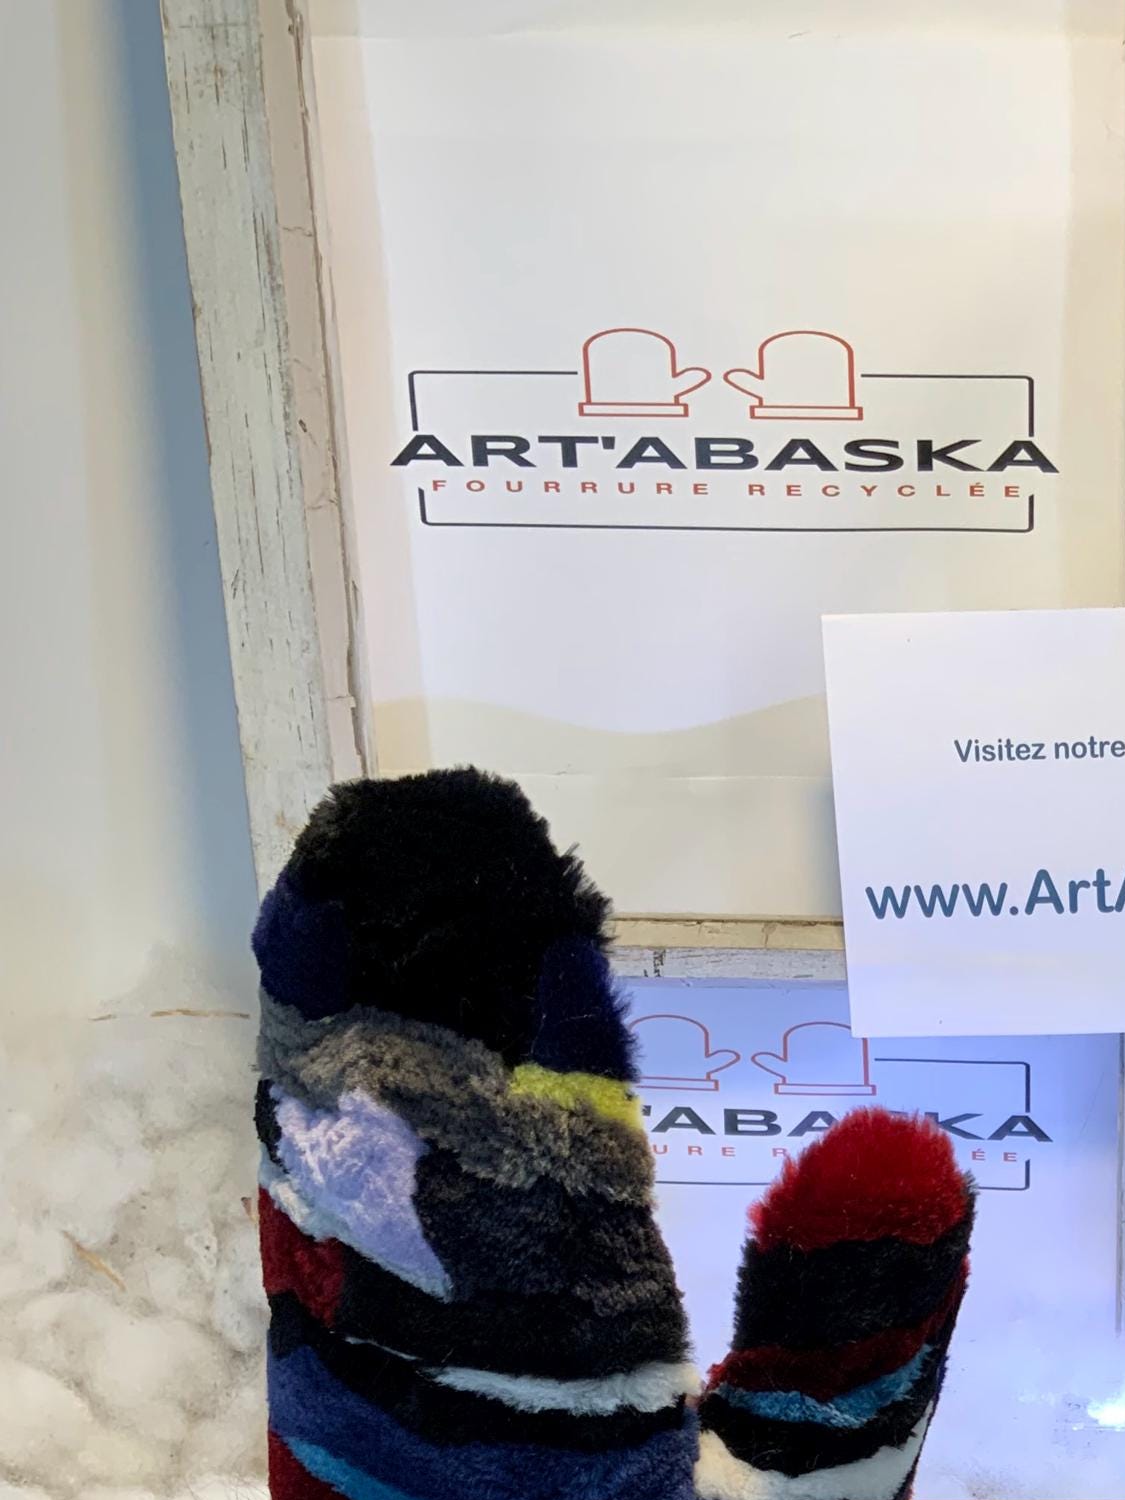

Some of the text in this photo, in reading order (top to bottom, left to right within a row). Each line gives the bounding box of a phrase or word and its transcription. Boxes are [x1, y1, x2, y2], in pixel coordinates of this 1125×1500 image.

[390, 433, 1060, 475] ART'ABASKA
[432, 479, 1021, 498] FOURRURE RECYCLÉE
[953, 737, 1047, 763] Visitez
